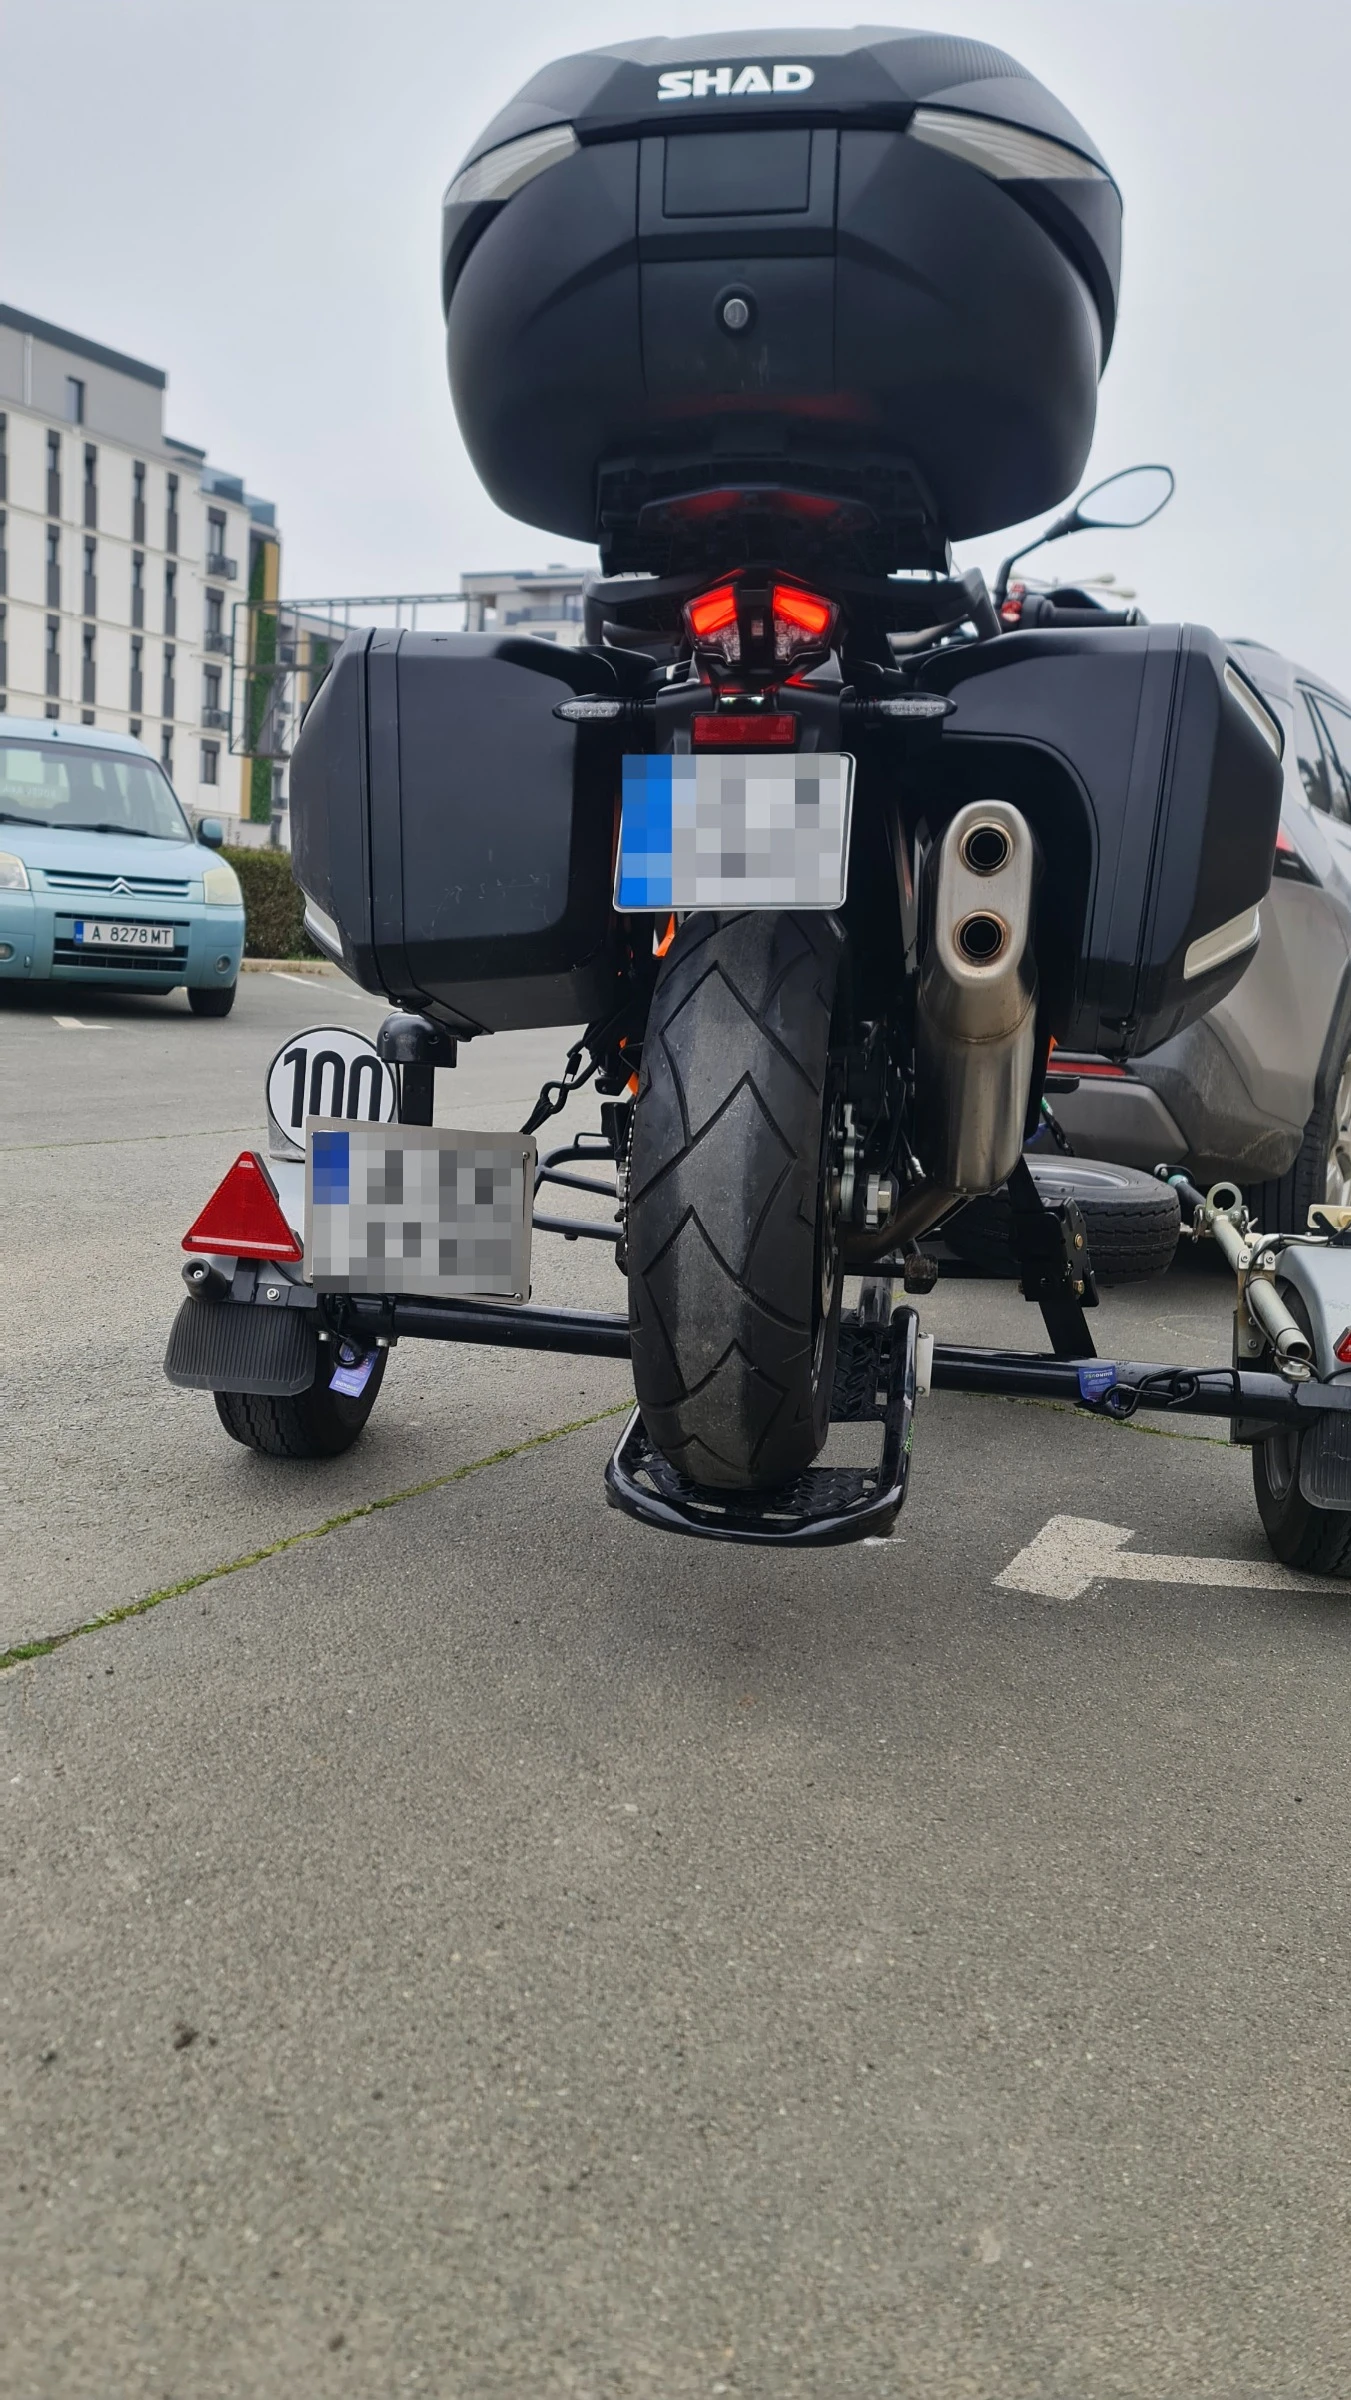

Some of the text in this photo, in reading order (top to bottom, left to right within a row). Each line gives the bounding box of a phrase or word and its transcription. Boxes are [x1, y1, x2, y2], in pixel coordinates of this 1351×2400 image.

[657, 64, 815, 101] SHAD
[92, 925, 101, 941] A
[283, 1047, 383, 1128] 100
